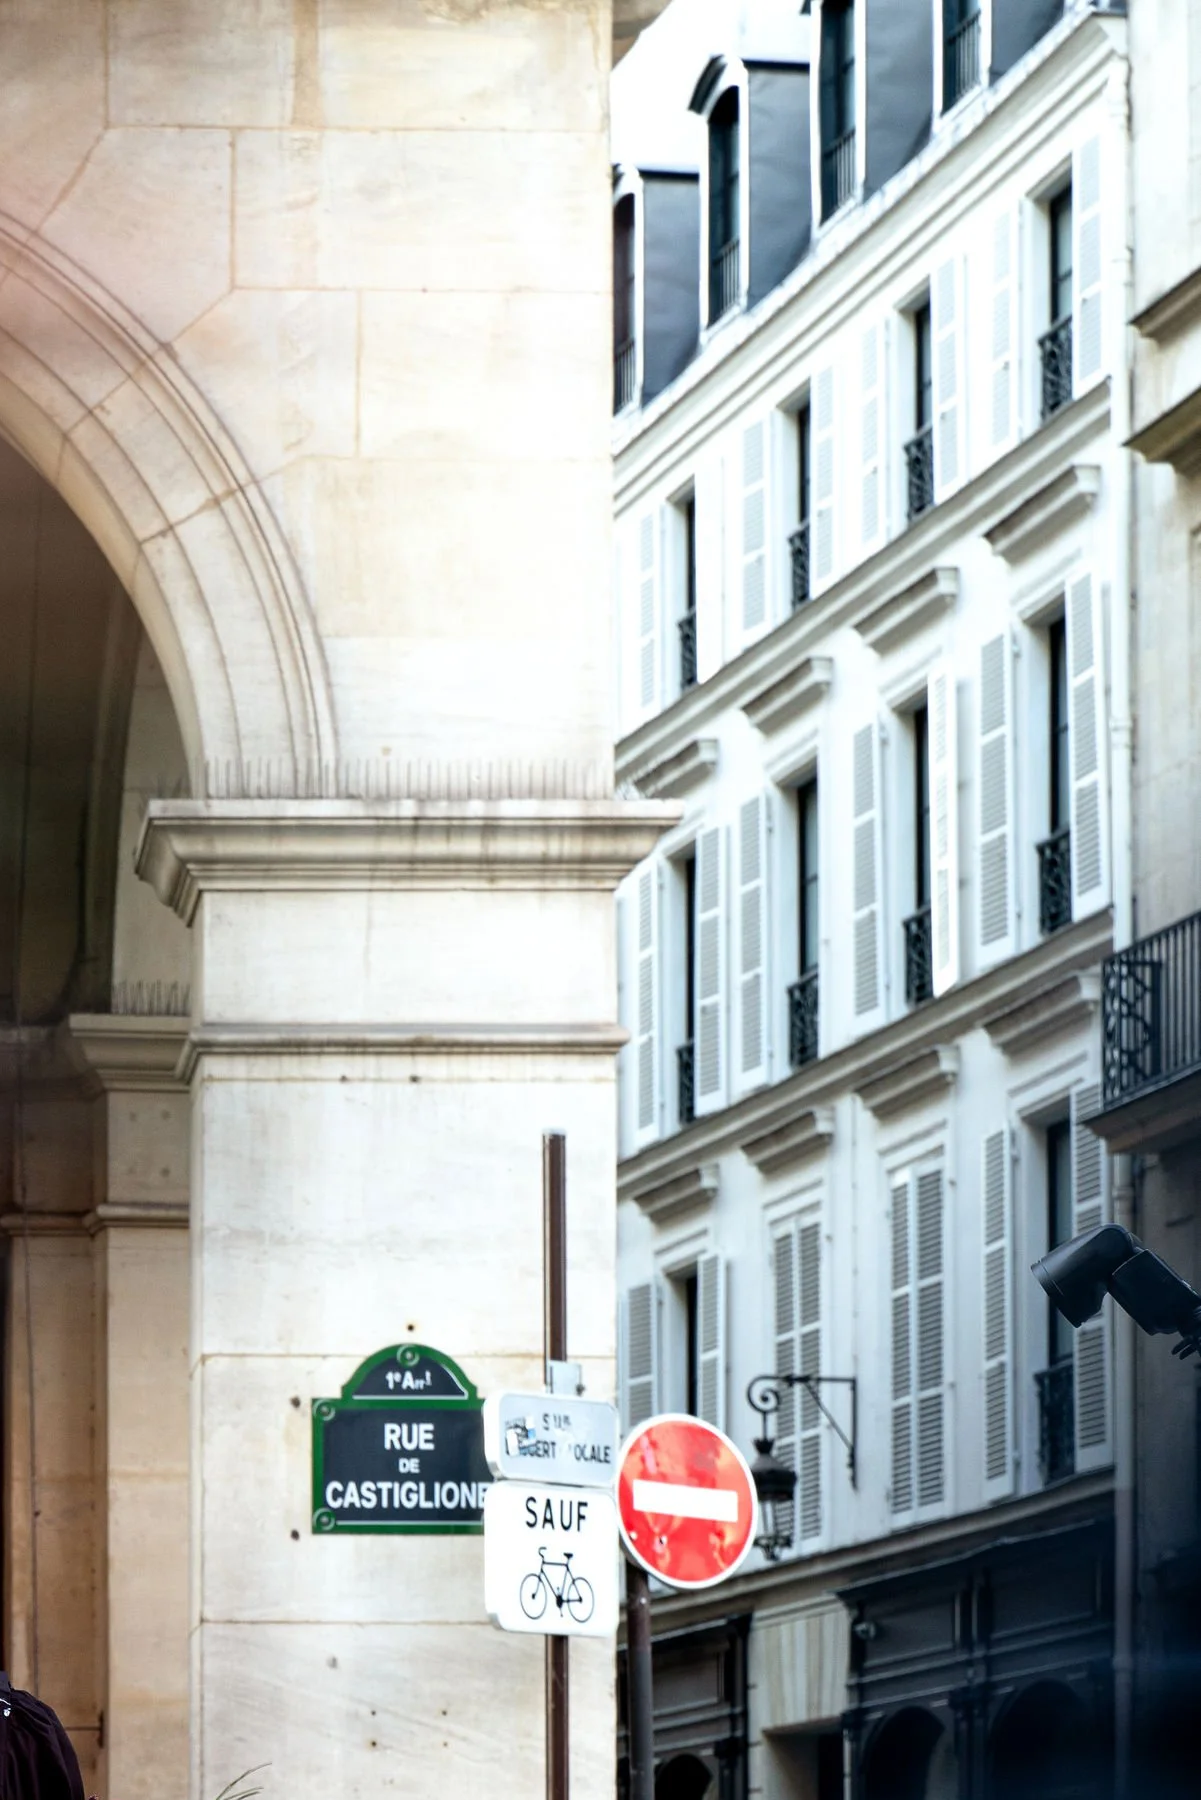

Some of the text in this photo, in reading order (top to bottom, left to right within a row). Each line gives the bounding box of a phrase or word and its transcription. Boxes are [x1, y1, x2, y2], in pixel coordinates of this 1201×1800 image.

[384, 1423, 435, 1450] RUE
[399, 1458, 420, 1473] DE
[567, 1443, 611, 1464] OCALE
[525, 1496, 588, 1532] SAUF
